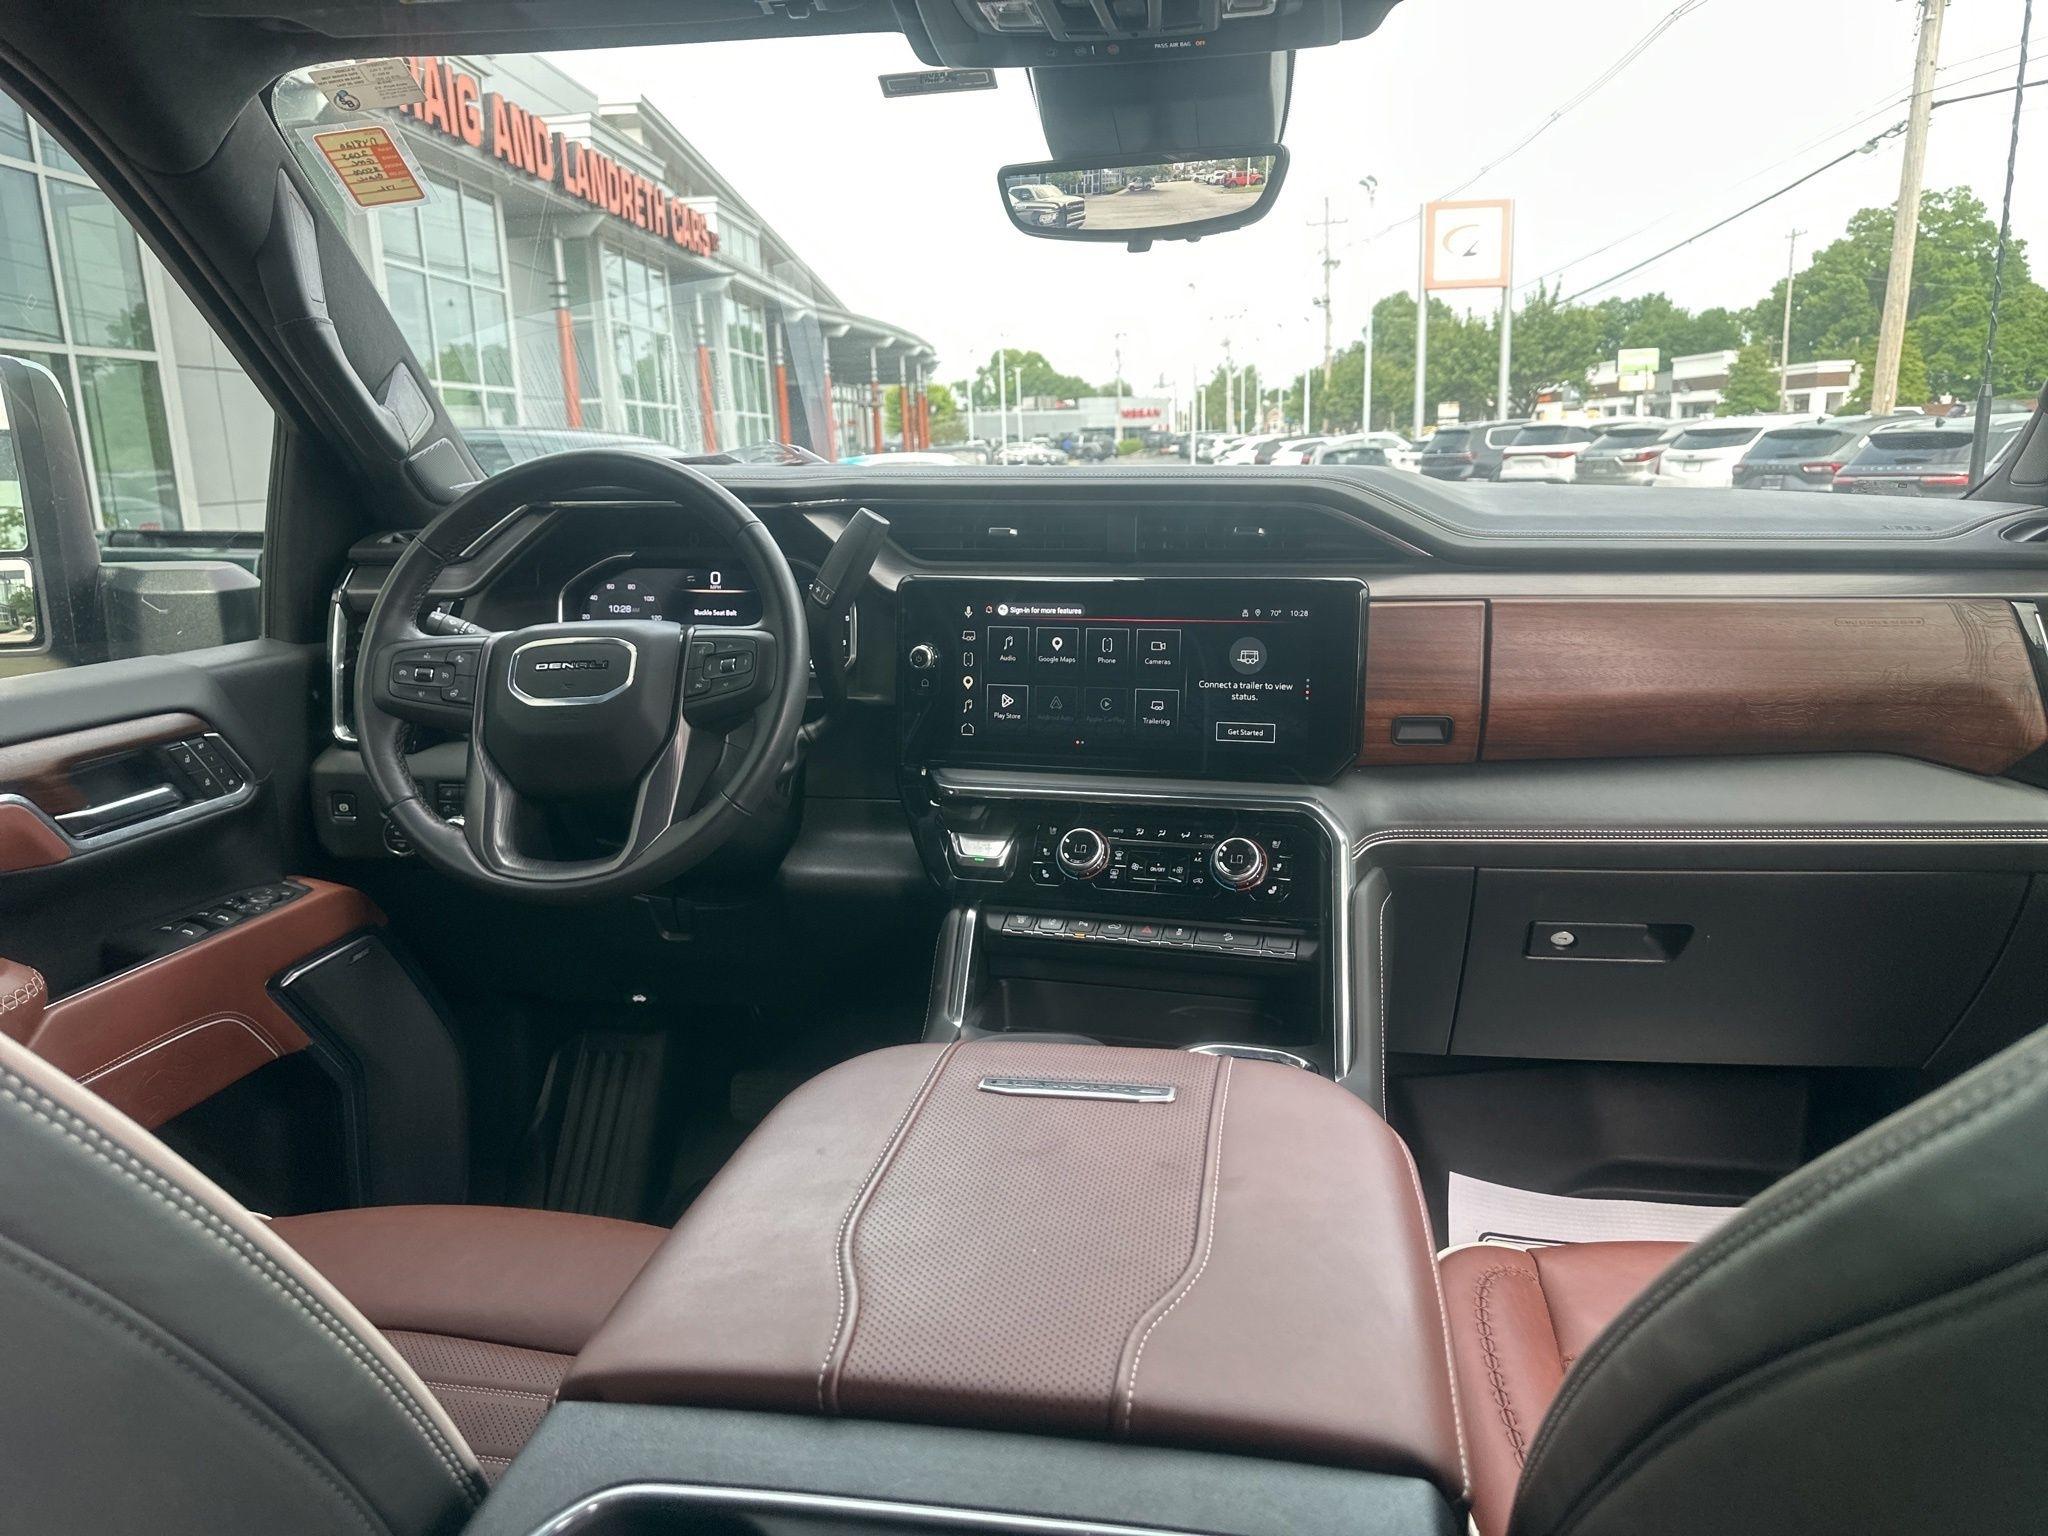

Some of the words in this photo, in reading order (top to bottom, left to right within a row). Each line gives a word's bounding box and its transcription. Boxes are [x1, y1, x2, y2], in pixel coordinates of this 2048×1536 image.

[400, 56, 482, 147] AIG
[492, 91, 554, 182] AND
[560, 132, 668, 238] LANDRETH
[671, 196, 711, 257] CARS
[710, 571, 721, 585] 0
[608, 605, 632, 613] 10:28
[1010, 607, 1030, 615] Sign-in
[1057, 607, 1082, 615] features
[1038, 656, 1059, 664] Google
[535, 661, 608, 670] DENALI
[1199, 681, 1231, 689] Connect
[1240, 682, 1262, 690] trailer
[1264, 682, 1273, 690] to
[994, 712, 1005, 720] Play
[1143, 718, 1171, 726] Trailering
